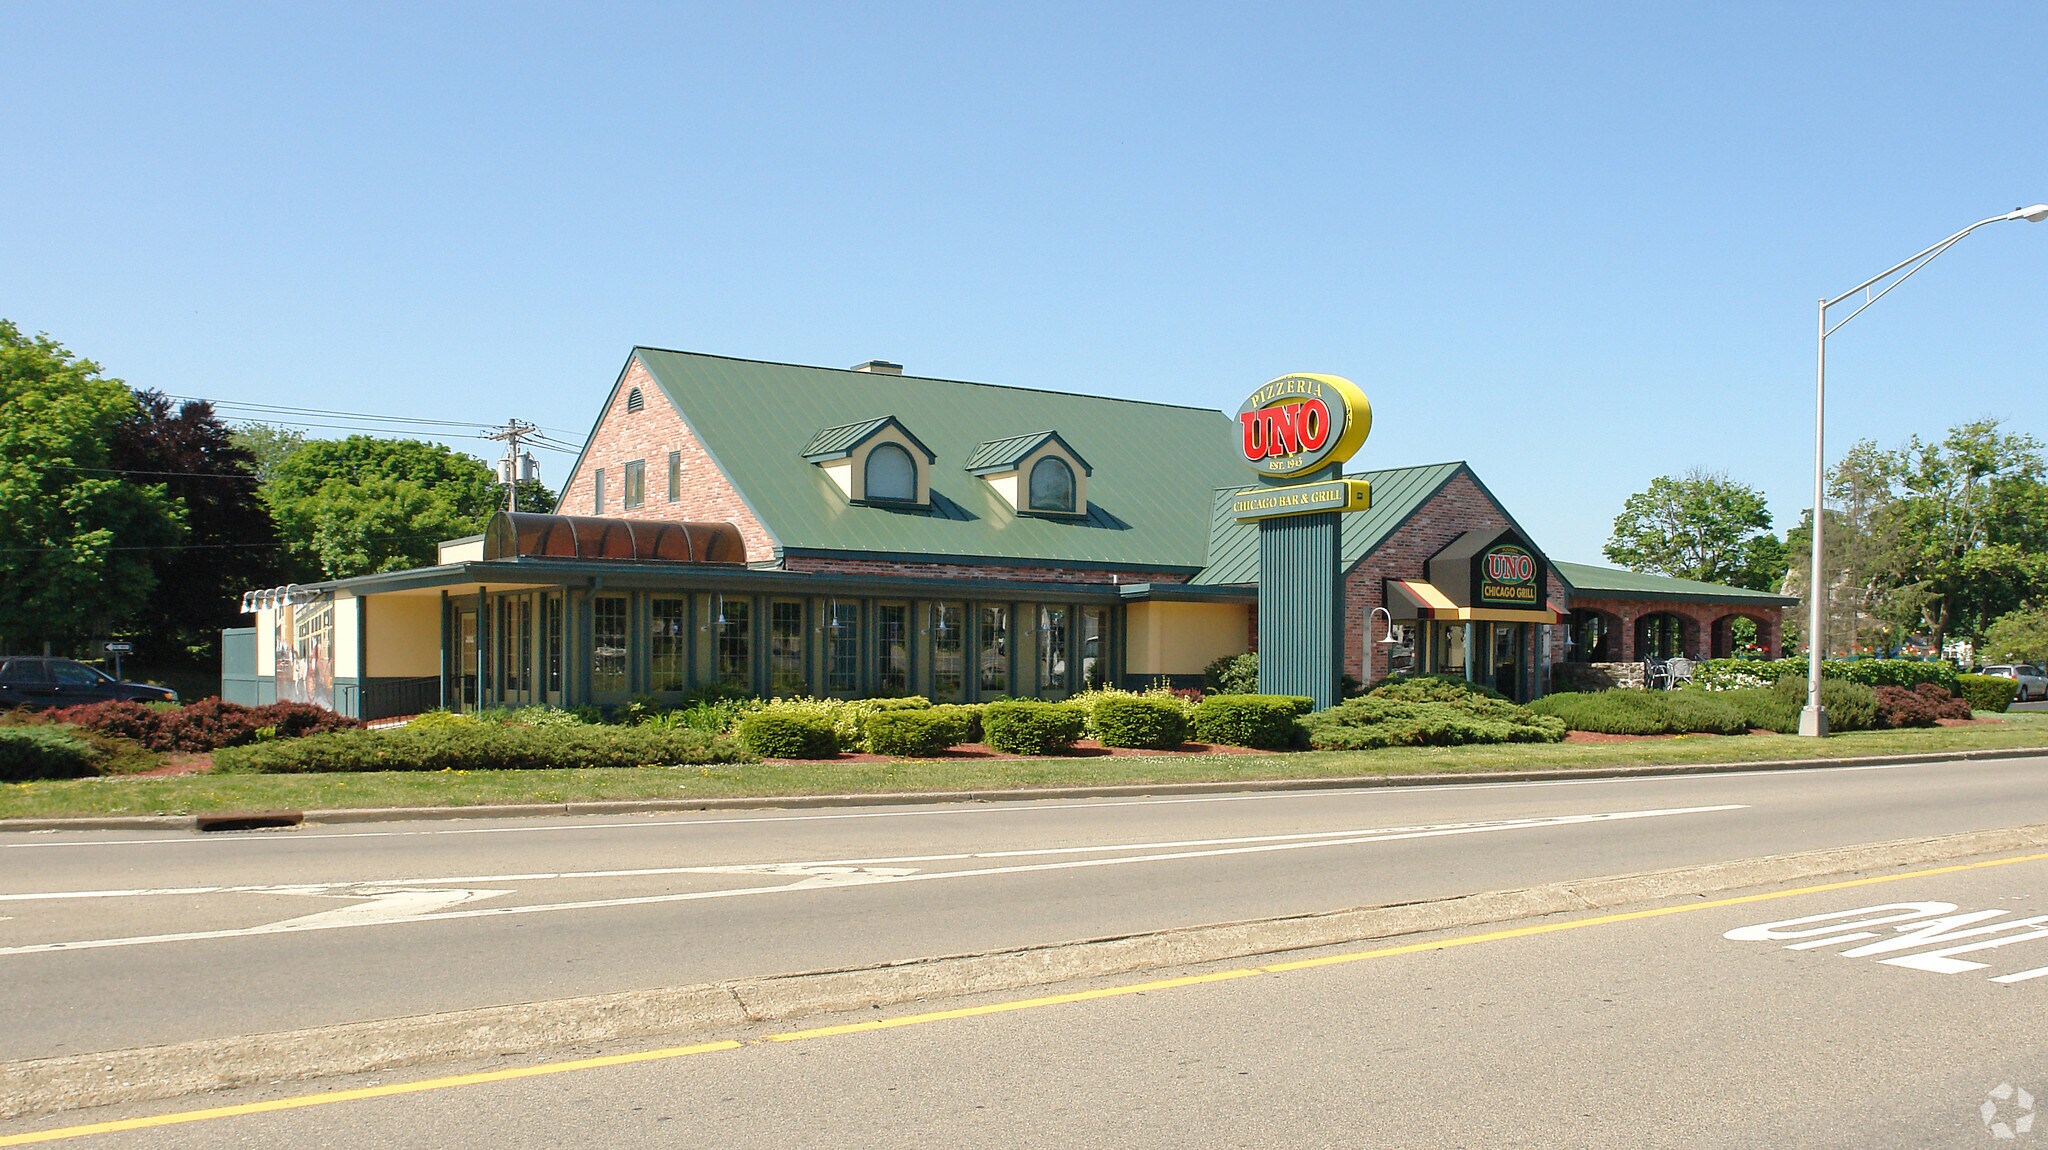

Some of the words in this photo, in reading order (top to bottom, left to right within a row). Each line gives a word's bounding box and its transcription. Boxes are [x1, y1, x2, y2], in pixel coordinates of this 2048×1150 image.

[1251, 379, 1322, 408] PIZZERIA
[1240, 398, 1331, 461] UNO
[1233, 497, 1277, 512] CHICAGO
[1279, 495, 1299, 507] BAR
[1300, 493, 1309, 504] &
[1311, 489, 1342, 503] GRILL
[1488, 553, 1533, 580] UNO
[1484, 585, 1516, 598] CHICAGO
[1516, 587, 1534, 598] GRILL
[1722, 900, 2048, 984] ONL
